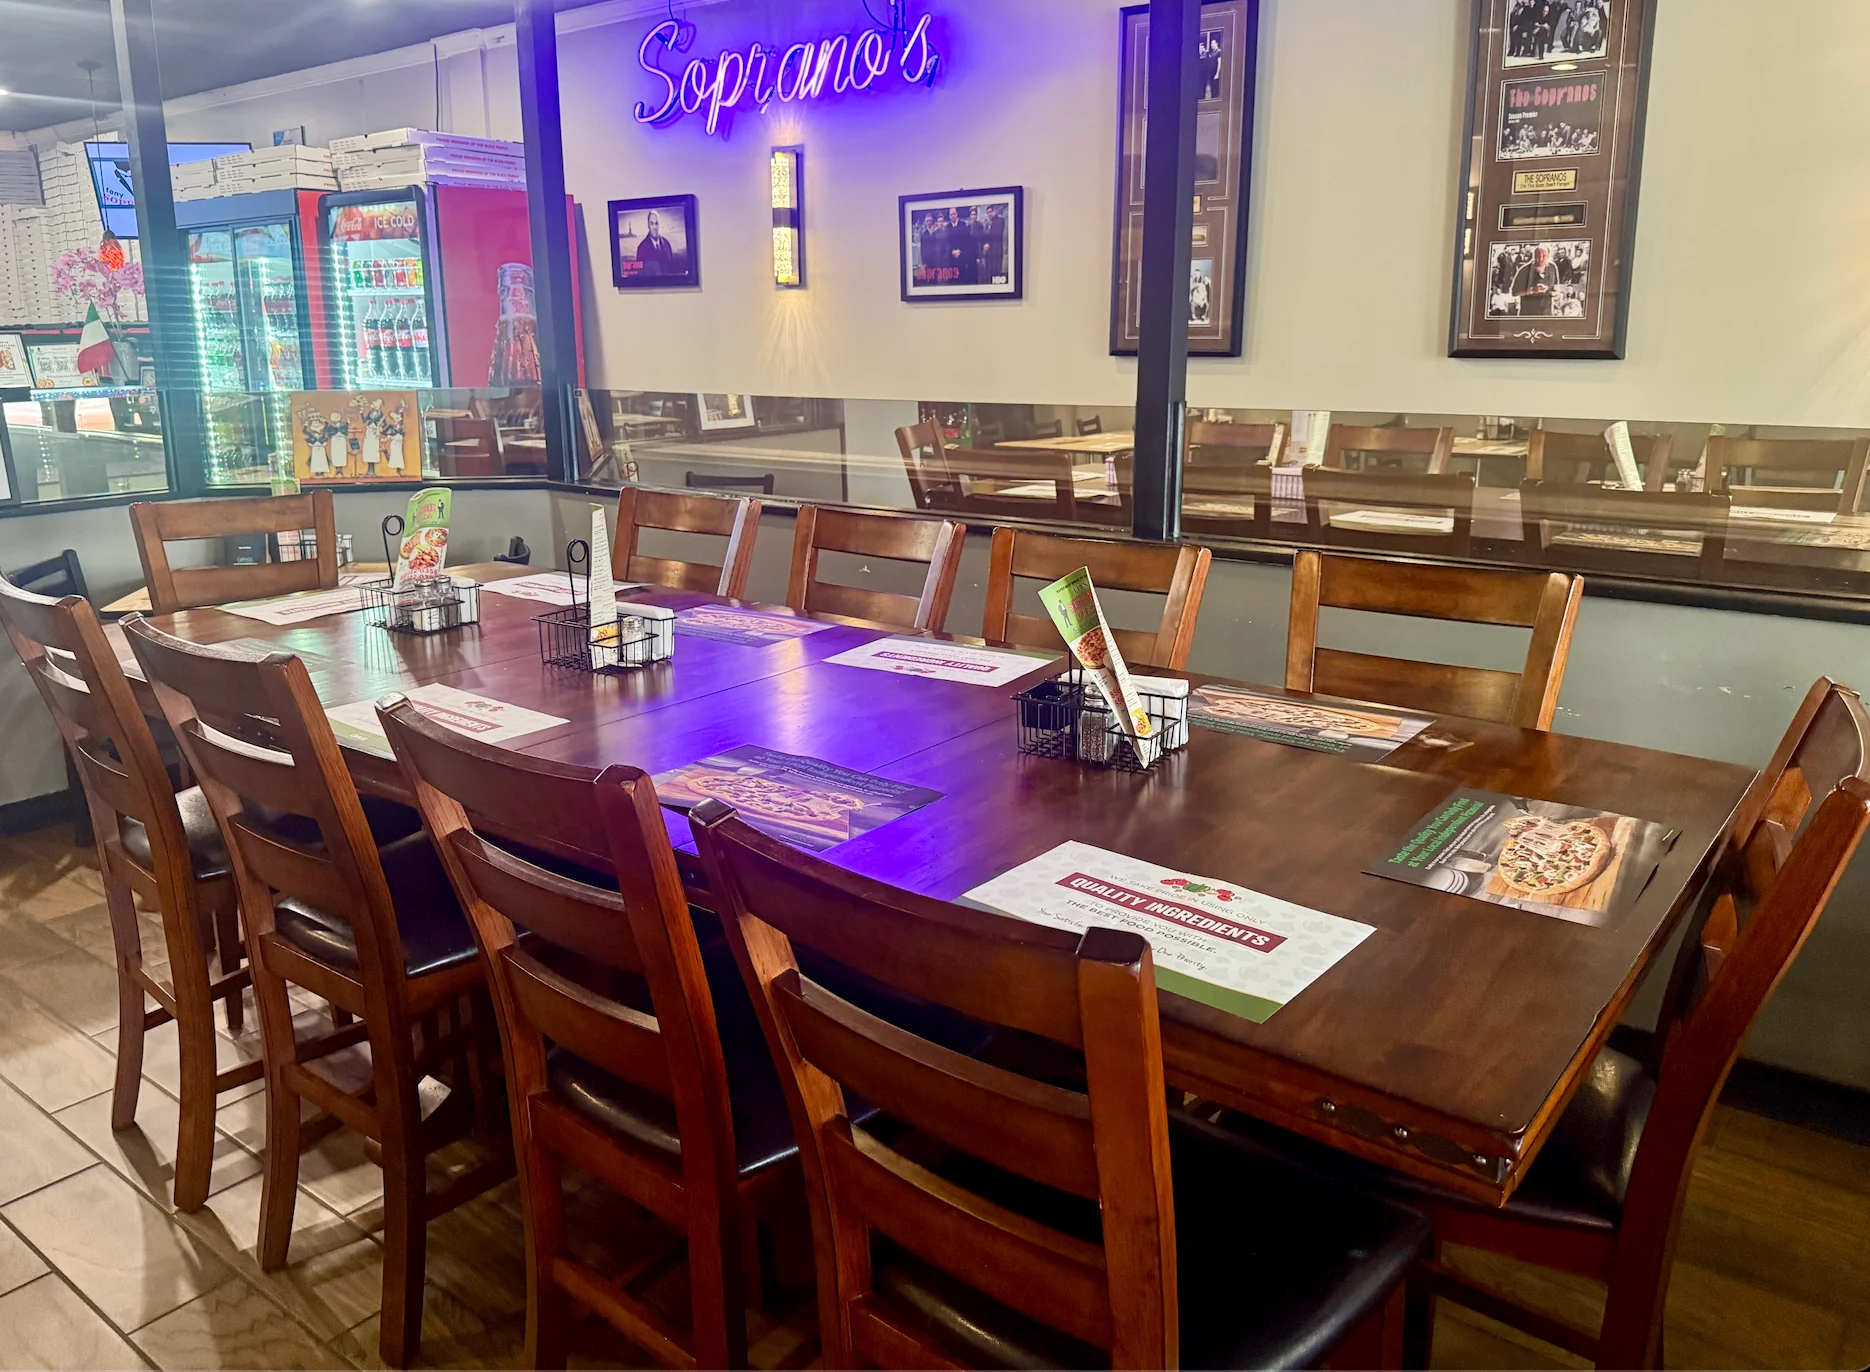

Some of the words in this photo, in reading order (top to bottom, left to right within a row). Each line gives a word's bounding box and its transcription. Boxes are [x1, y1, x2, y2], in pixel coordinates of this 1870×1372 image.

[1509, 88, 1531, 108] The
[1534, 84, 1597, 107] Sopranos
[1535, 172, 1567, 183] SOPRANOS
[106, 187, 124, 198] tony
[374, 217, 388, 229] ICE
[390, 215, 415, 228] COLD
[991, 276, 1007, 284] HBO
[1110, 874, 1125, 882] WE
[1126, 879, 1155, 891] TAKE
[1156, 888, 1187, 900] PRIDE
[1201, 901, 1234, 915] USING
[1236, 912, 1267, 925] ONLY
[1054, 913, 1086, 929] Satisfac
[1070, 878, 1147, 906] QUALITY
[1144, 901, 1271, 946] INGREDIENTS
[1091, 901, 1104, 909] TO
[1105, 907, 1151, 925] PROVIDE
[1153, 922, 1177, 933] YOU
[1179, 931, 1207, 943] WITH
[1066, 900, 1088, 910] THE
[1089, 907, 1121, 920] BEST
[1120, 919, 1154, 932] FOOD
[1156, 931, 1217, 954] POSSIBLE.
